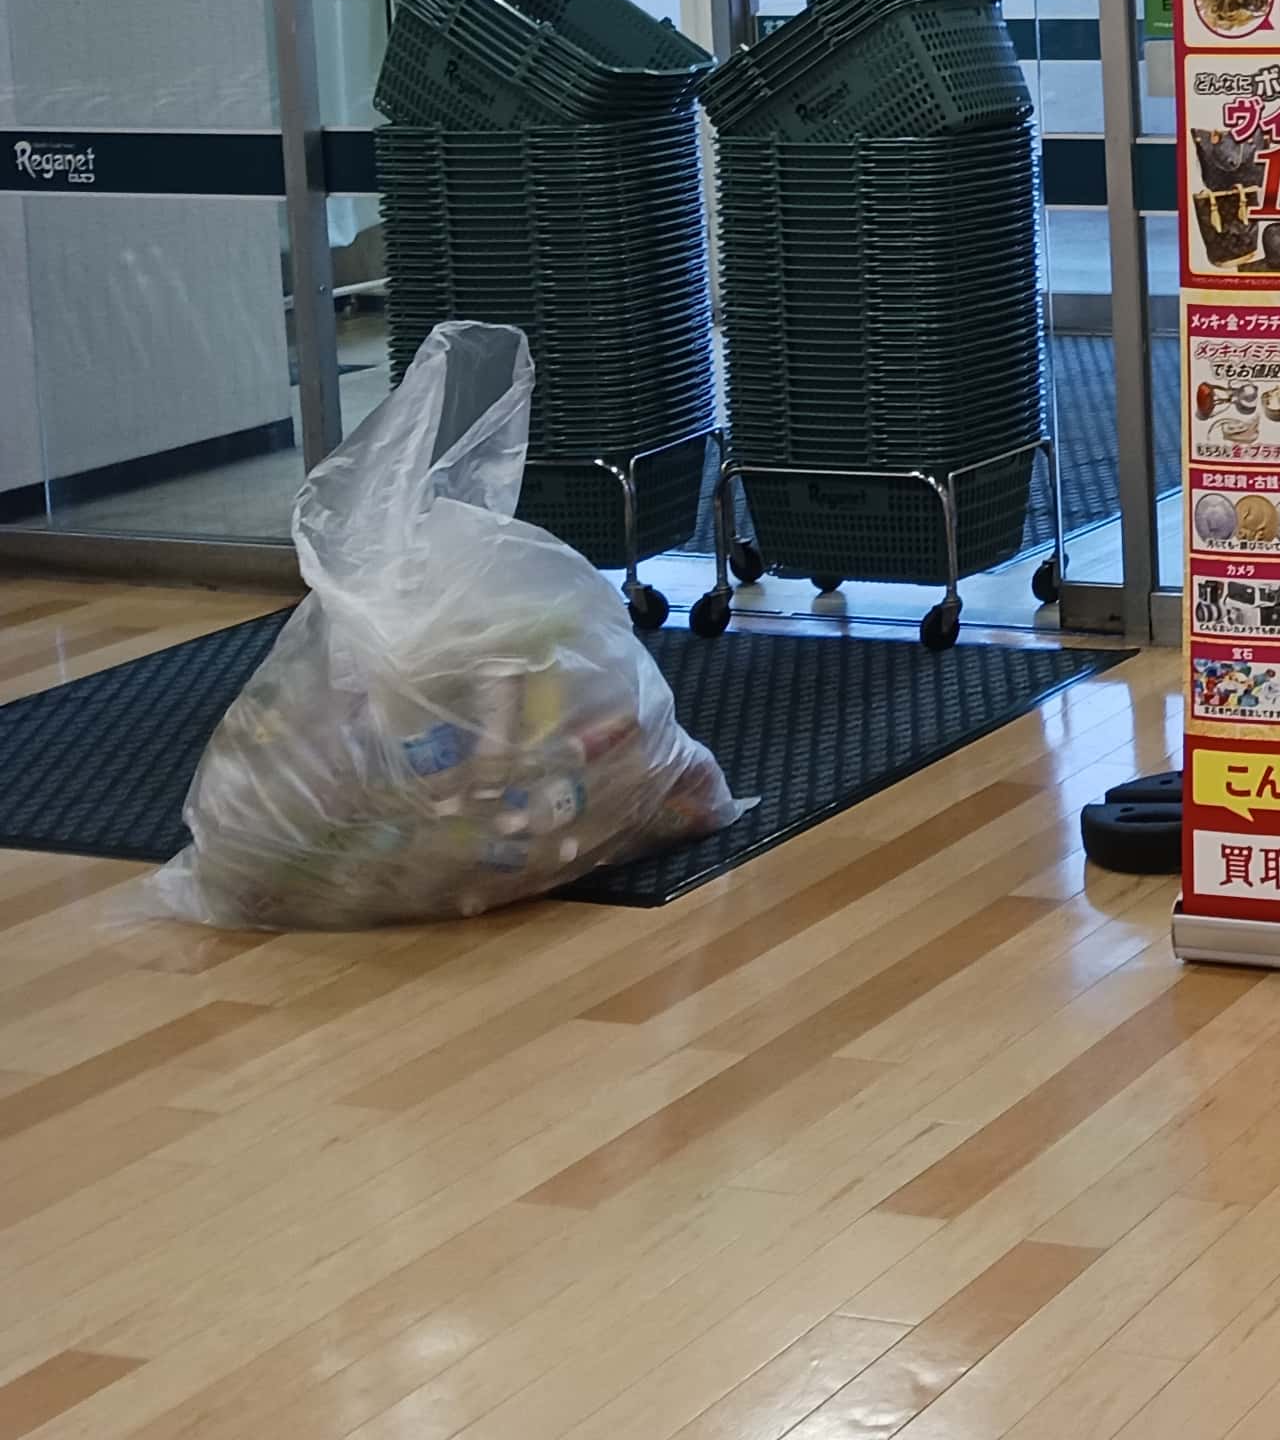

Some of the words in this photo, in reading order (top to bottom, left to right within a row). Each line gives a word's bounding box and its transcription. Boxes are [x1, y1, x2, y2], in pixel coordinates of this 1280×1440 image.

[14, 141, 95, 178] Reganet
[1227, 564, 1255, 576] カメラ
